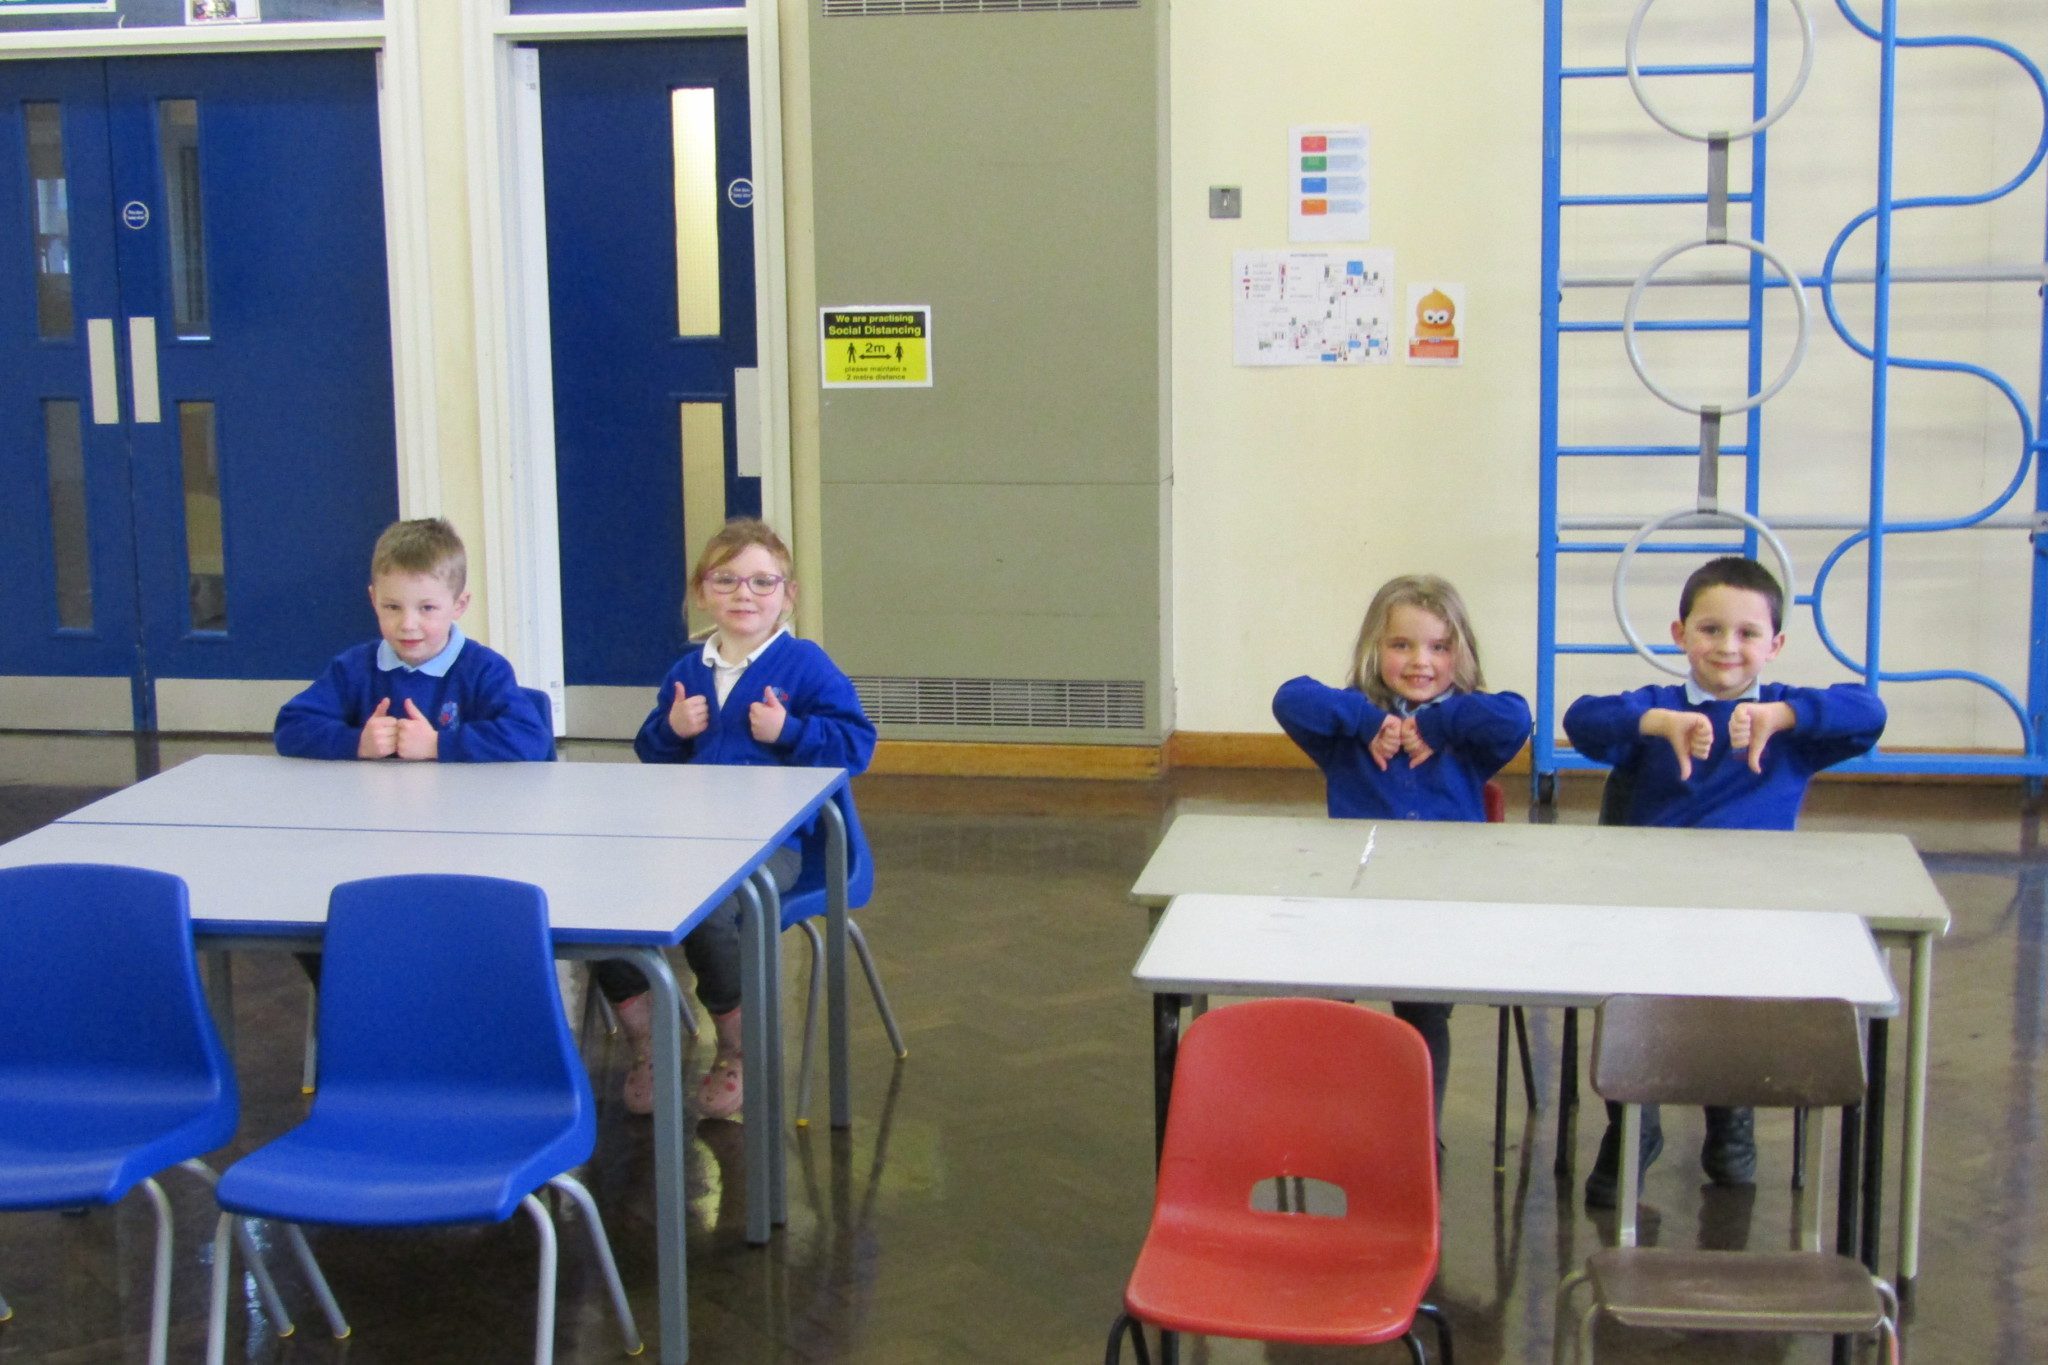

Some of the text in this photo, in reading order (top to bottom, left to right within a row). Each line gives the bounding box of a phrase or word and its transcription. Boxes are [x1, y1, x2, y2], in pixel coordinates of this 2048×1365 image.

[835, 314, 850, 323] We
[869, 314, 914, 324] practising
[828, 325, 922, 337] Social Distancing
[865, 342, 885, 353] 2m
